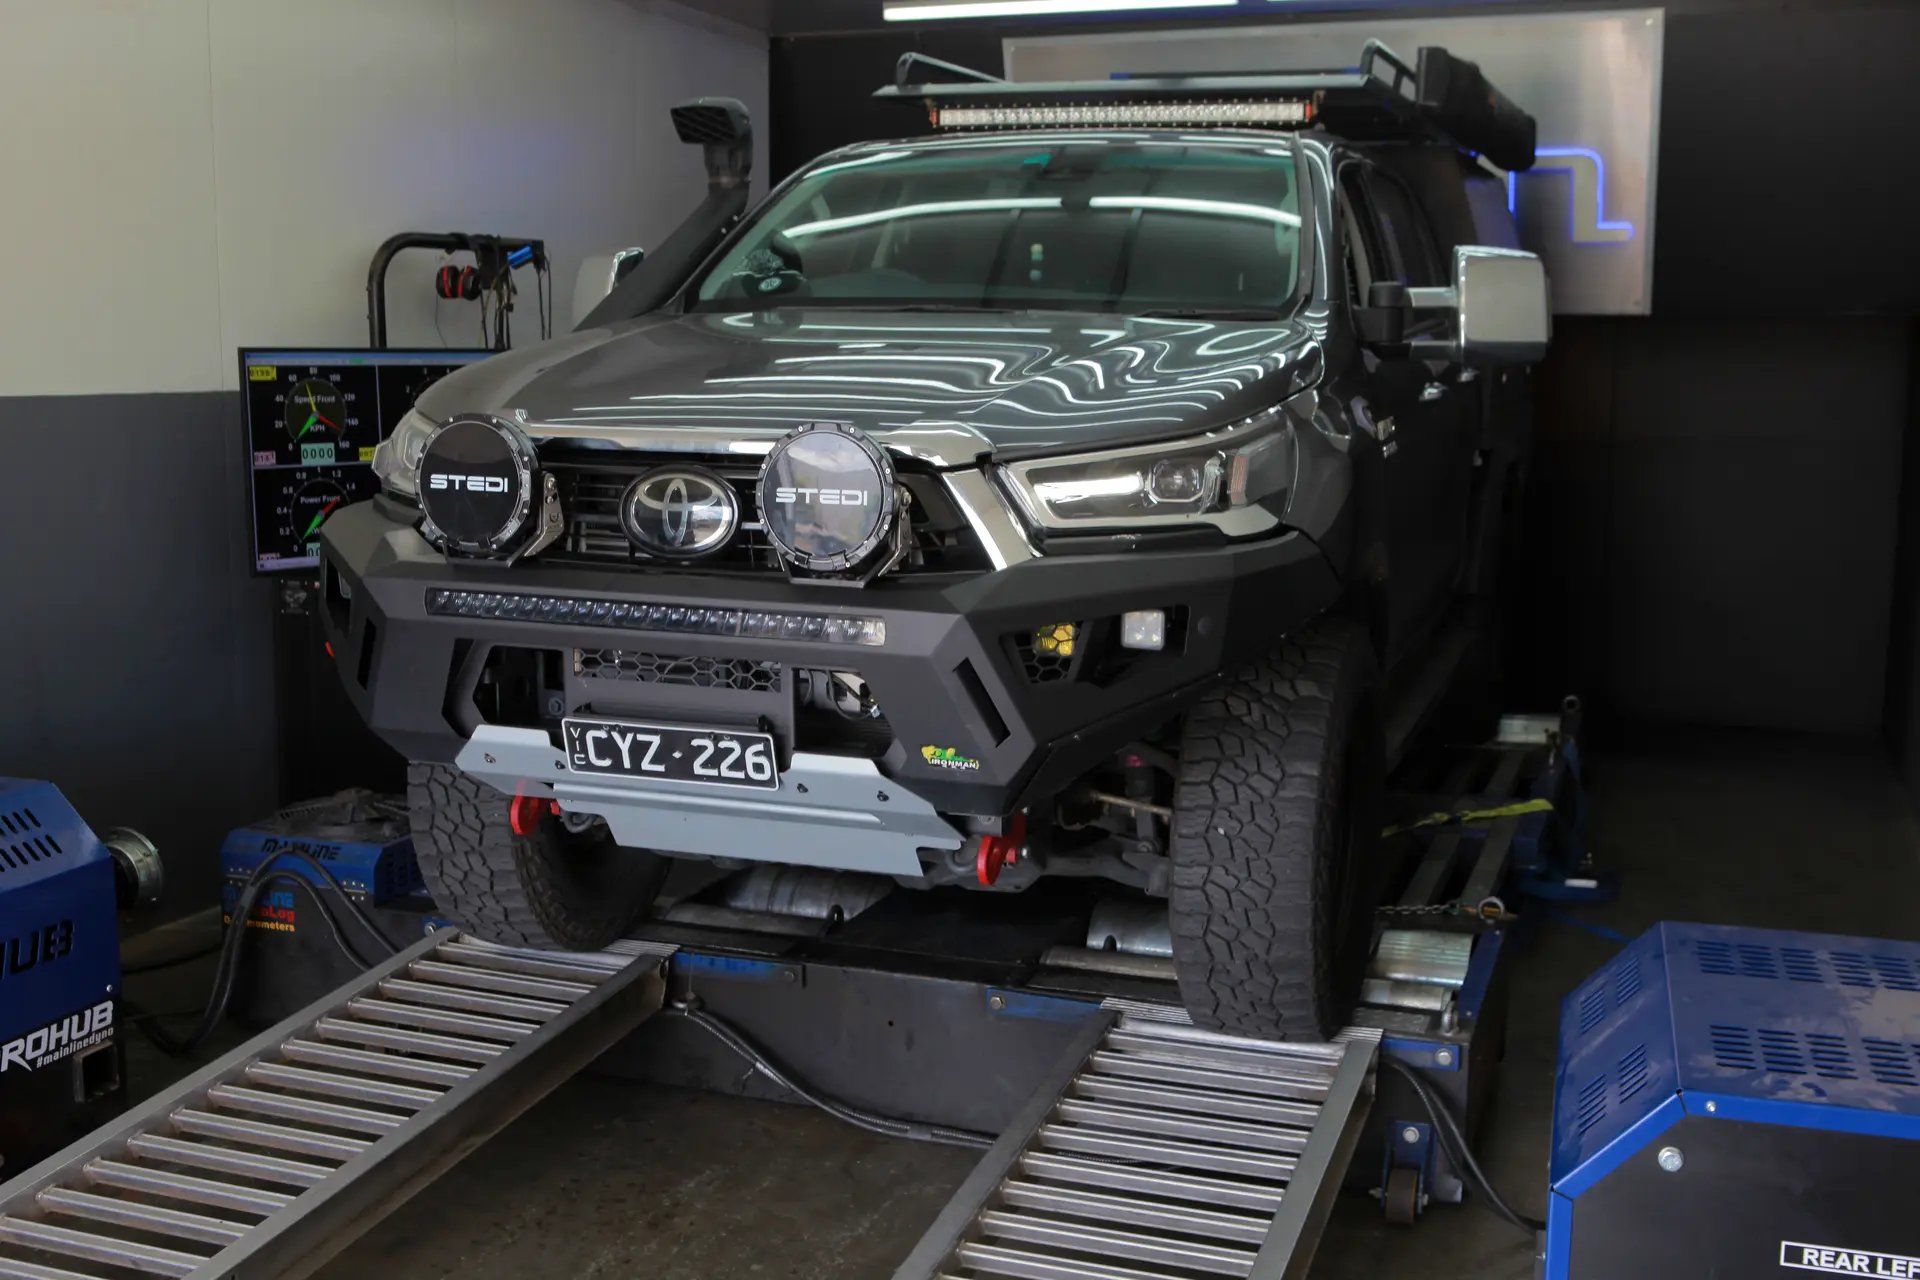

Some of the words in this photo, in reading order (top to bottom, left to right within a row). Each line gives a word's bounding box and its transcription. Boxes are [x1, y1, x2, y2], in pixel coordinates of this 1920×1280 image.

[310, 424, 325, 432] KPH
[302, 447, 333, 460] 0000
[430, 473, 508, 493] STEDI
[775, 486, 869, 507] STEDI
[569, 727, 586, 765] VIC
[931, 758, 976, 769] IRONMAN
[0, 1000, 114, 1072] ROHUB
[36, 1026, 114, 1069] #mainlinedyno
[1802, 1247, 1870, 1273] REAR
[1876, 1257, 1920, 1279] LEF
